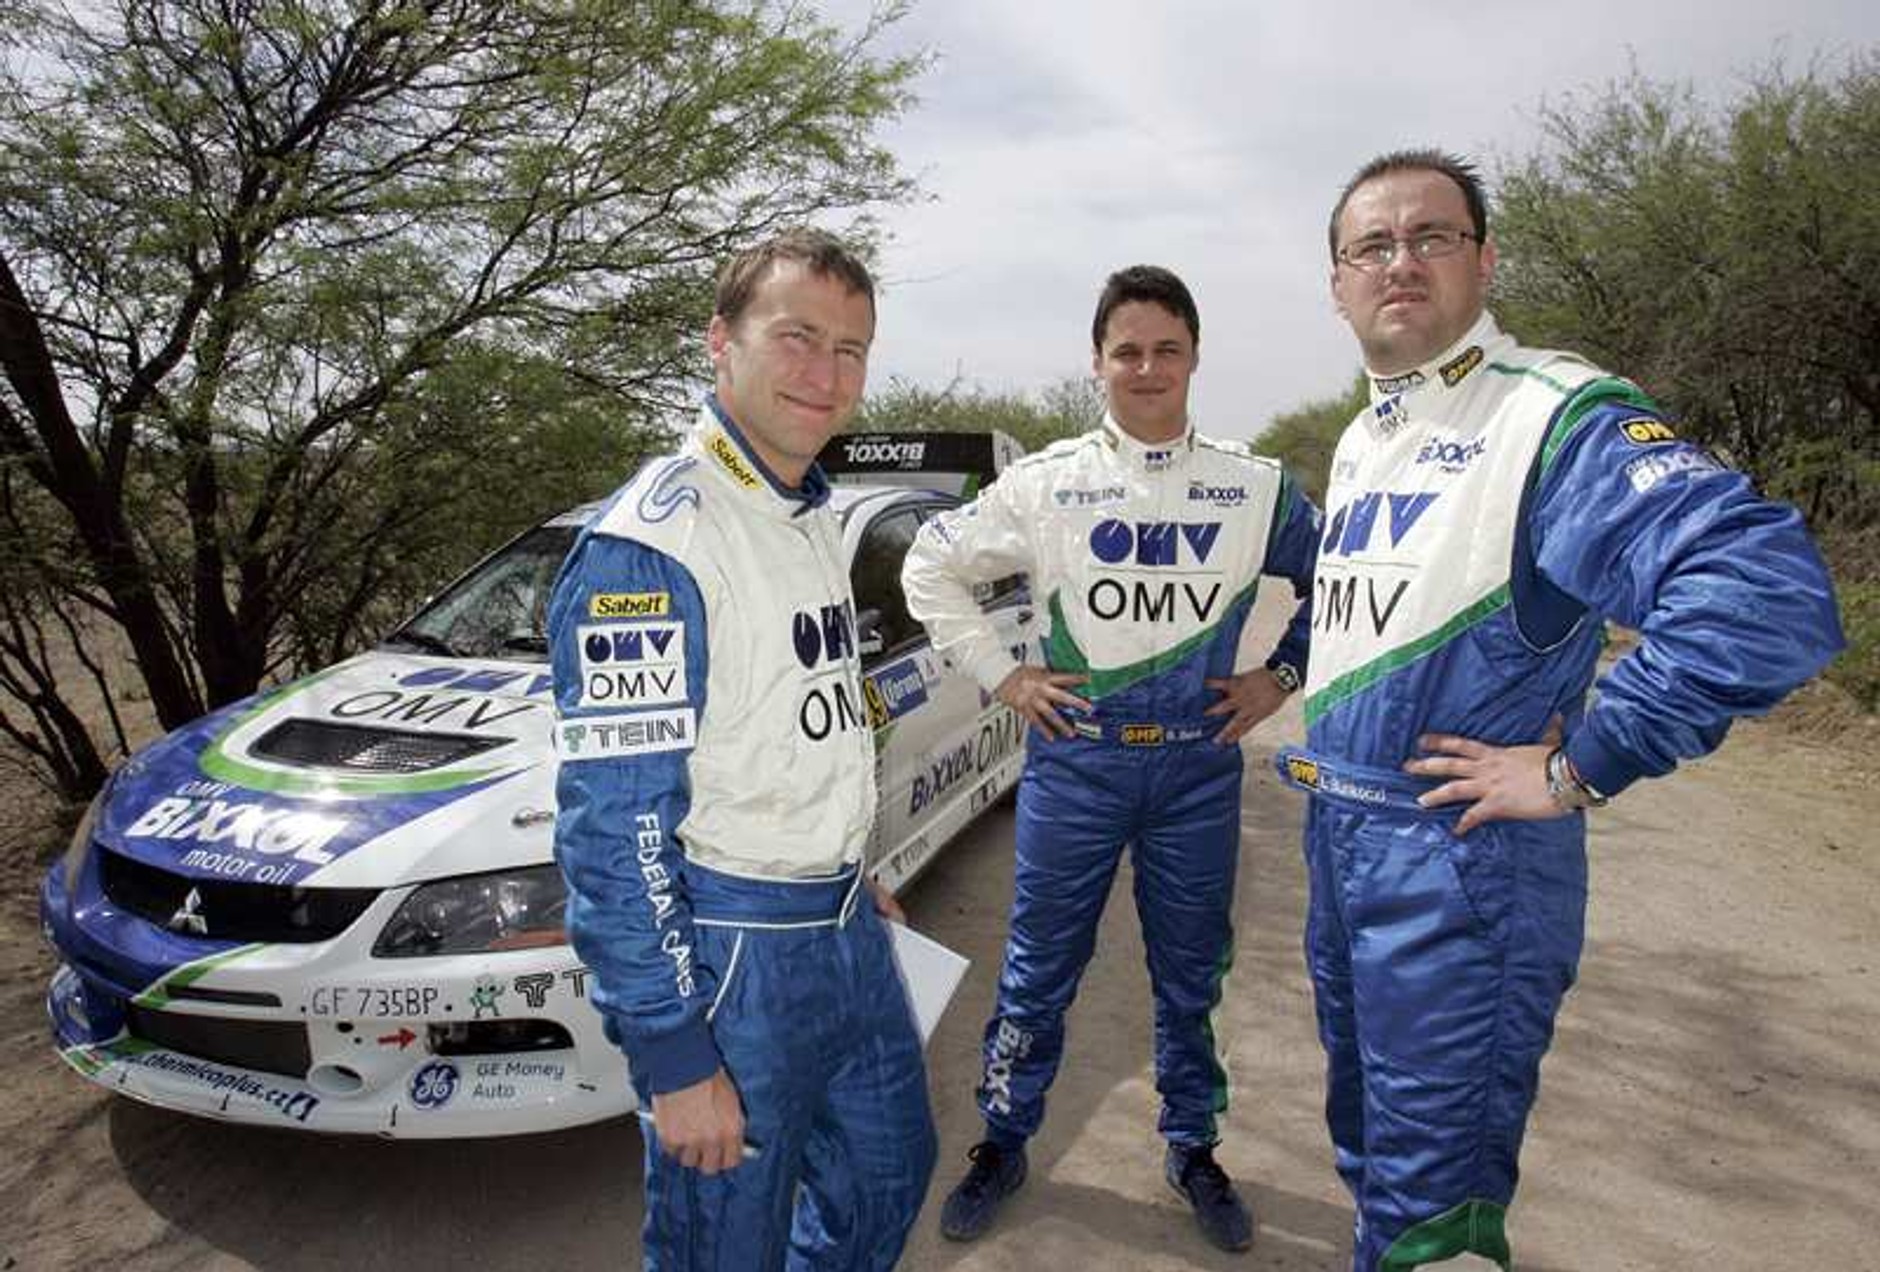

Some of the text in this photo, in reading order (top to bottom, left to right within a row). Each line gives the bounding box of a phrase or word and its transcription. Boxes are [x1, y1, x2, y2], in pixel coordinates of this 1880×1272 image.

[1087, 578, 1223, 622] OMV
[589, 667, 677, 701] OMV
[330, 691, 538, 730] OMV
[590, 716, 687, 749] TEIN
[181, 849, 298, 885] motor oil
[311, 986, 440, 1018] GF 735BP
[476, 1062, 565, 1080] GE Money
[473, 1083, 517, 1099] Auto
